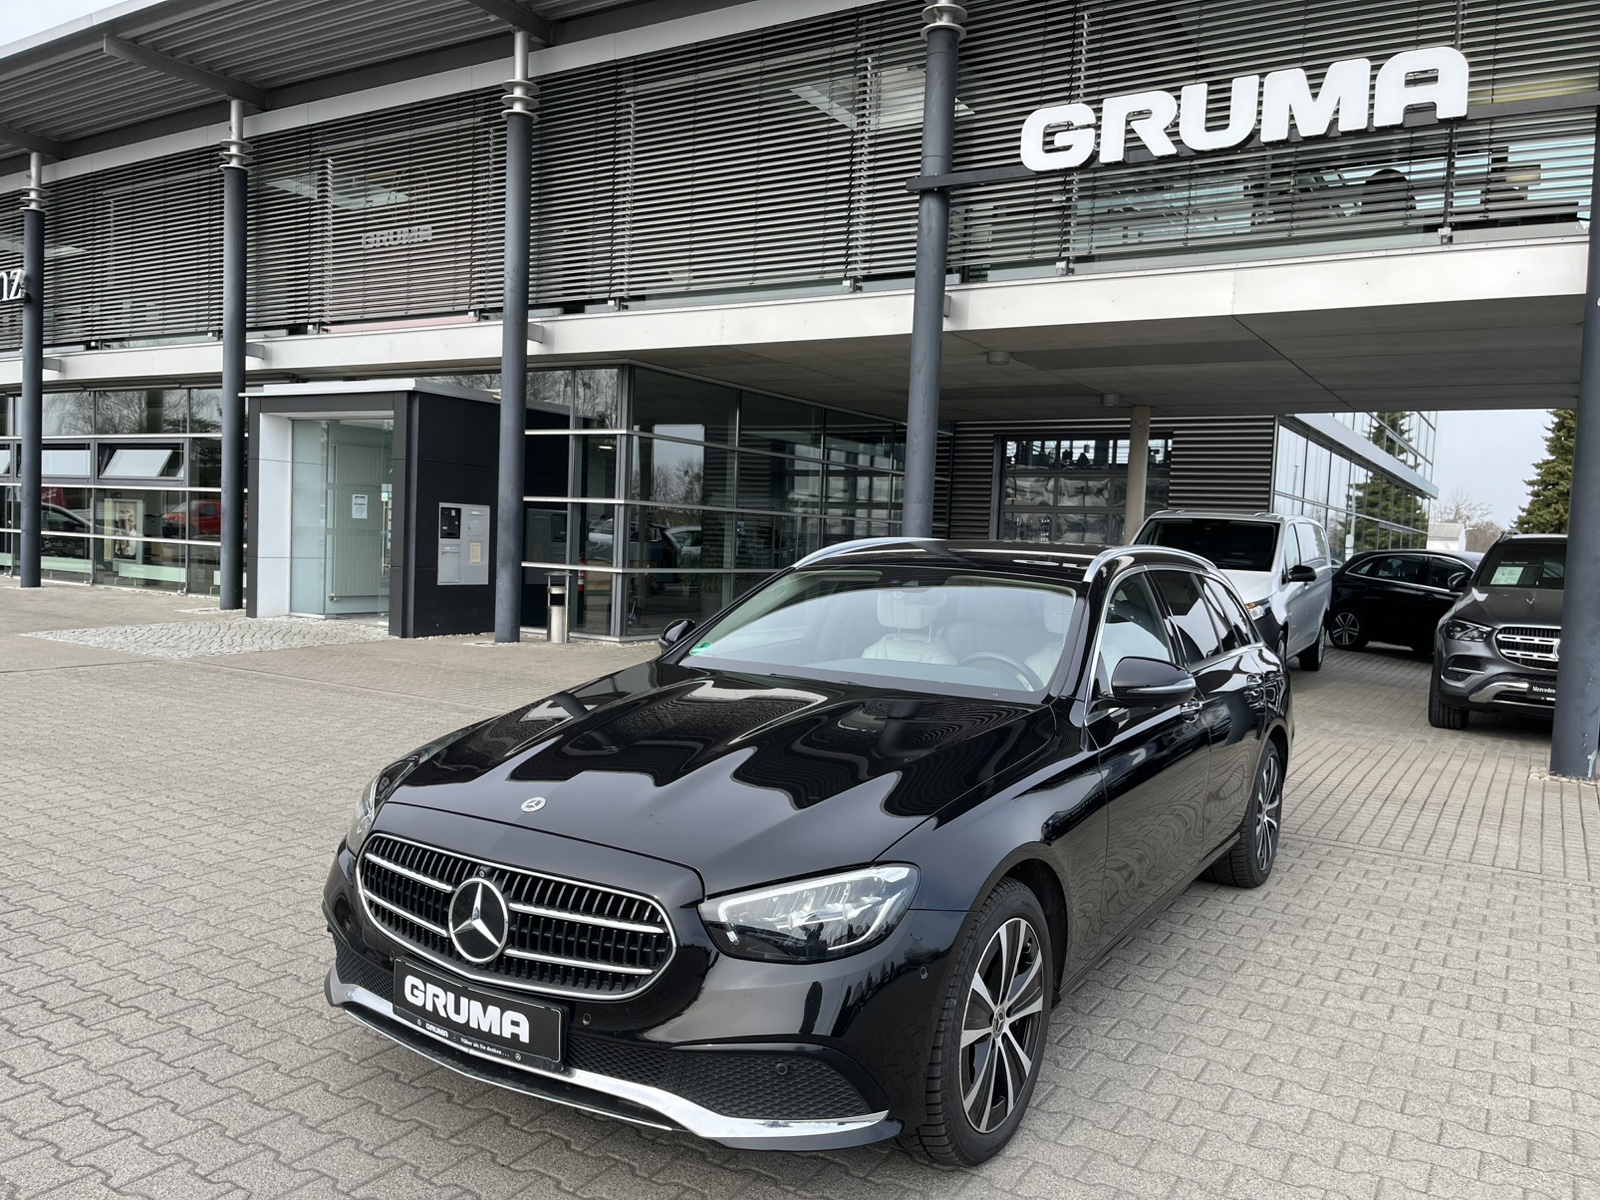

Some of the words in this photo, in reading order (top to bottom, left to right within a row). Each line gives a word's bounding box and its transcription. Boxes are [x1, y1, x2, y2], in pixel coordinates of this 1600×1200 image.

[1020, 46, 1469, 172] GRUMA
[361, 225, 433, 249] GRUMA
[404, 975, 529, 1044] GRUMA
[425, 1023, 449, 1038] GRUMA
